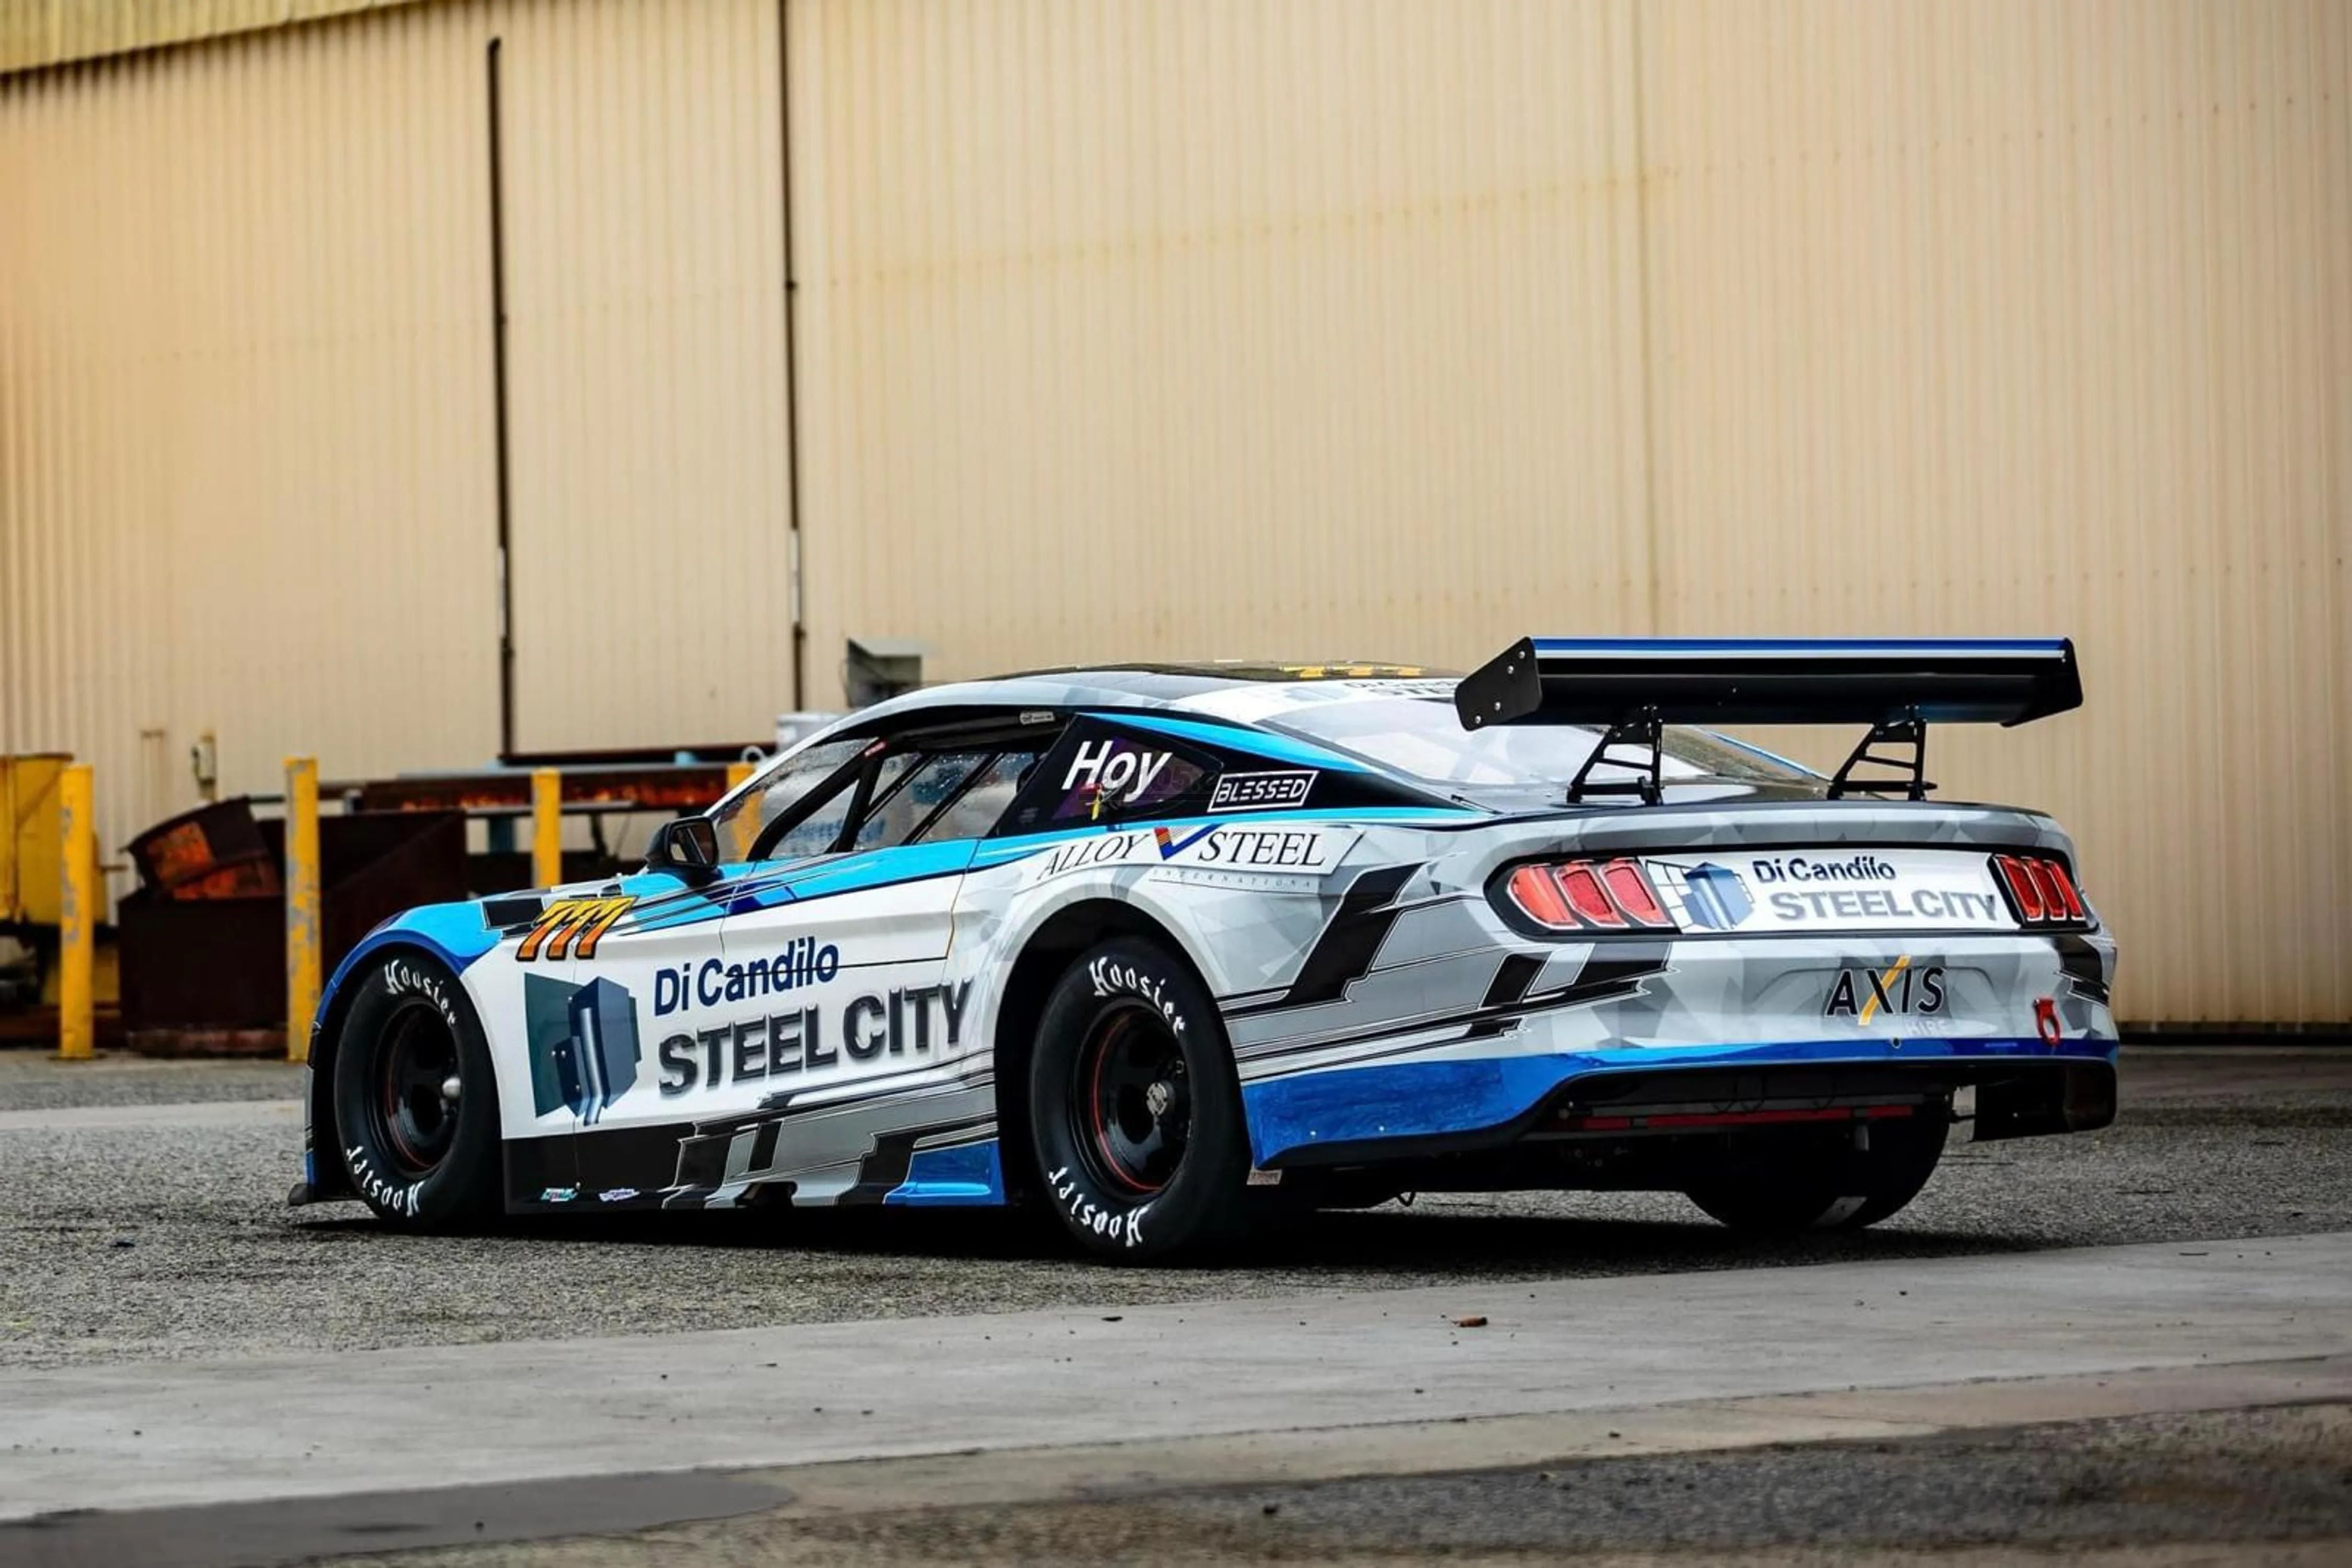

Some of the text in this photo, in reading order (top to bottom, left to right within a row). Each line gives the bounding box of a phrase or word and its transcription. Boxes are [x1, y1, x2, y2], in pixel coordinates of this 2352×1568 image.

[1062, 740, 1172, 802] Hoy
[1215, 777, 1307, 803] BLESSED
[1037, 832, 1329, 880] ALLOY STEEL
[1752, 856, 1897, 883] Di Candilo
[1769, 890, 1999, 923] STEEL CITY
[653, 936, 839, 1016] Di Candilo
[1088, 956, 1185, 1035] Hoosier
[1825, 954, 1947, 1027] AXIS
[658, 977, 976, 1098] STEEL CITY
